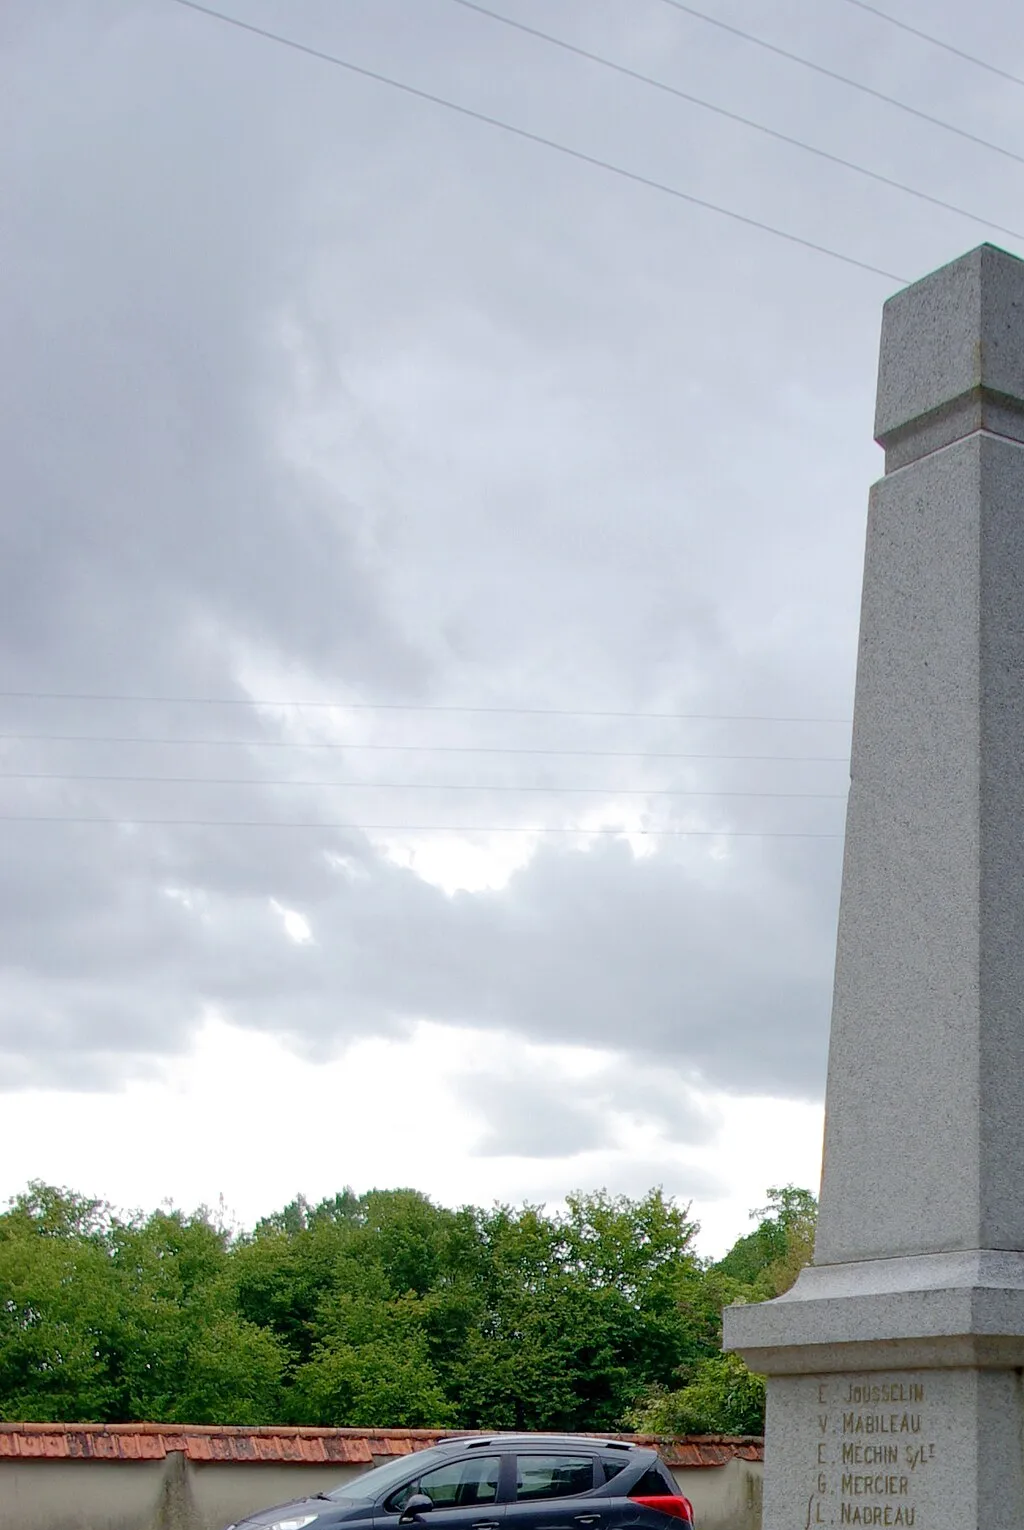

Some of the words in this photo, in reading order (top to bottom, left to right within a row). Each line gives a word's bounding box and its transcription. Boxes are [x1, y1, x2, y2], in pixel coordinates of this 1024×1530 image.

[844, 1383, 924, 1403] JOUSSELIN
[818, 1414, 835, 1434] V.
[843, 1412, 921, 1433] MABILEAU
[818, 1444, 835, 1464] E.
[818, 1473, 834, 1495] G.
[841, 1473, 908, 1495] MERCIER
[816, 1502, 834, 1525] L.
[841, 1502, 915, 1526] NADREAU
